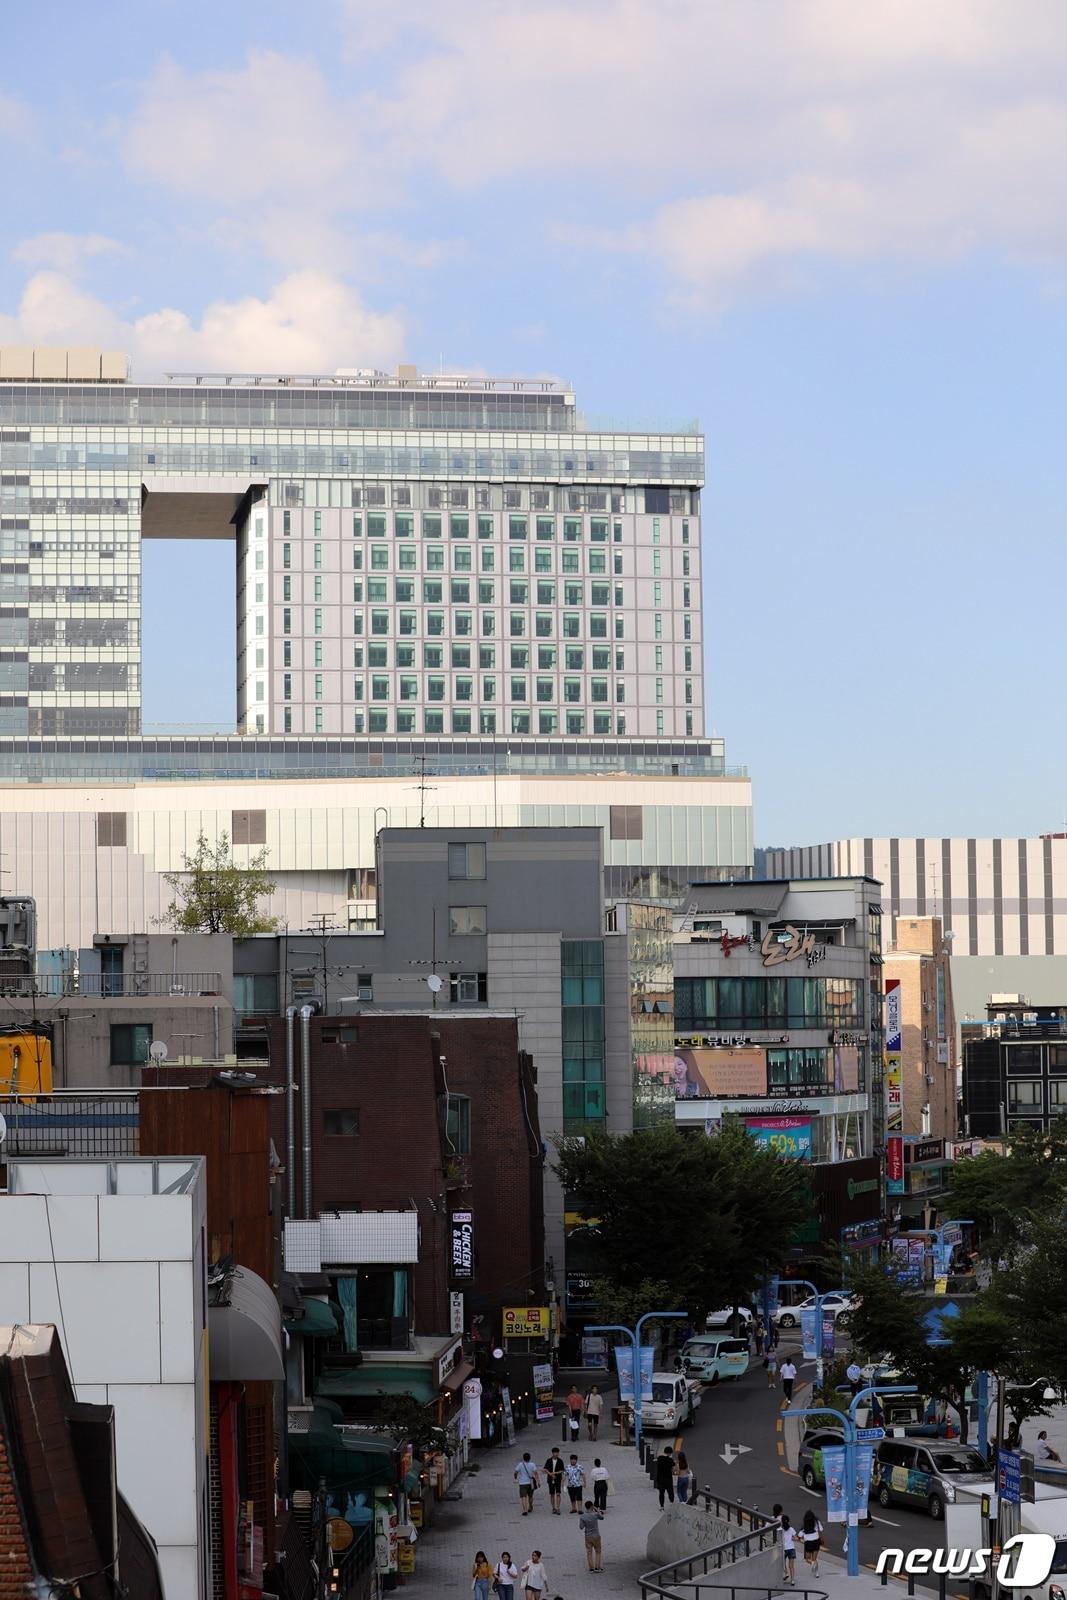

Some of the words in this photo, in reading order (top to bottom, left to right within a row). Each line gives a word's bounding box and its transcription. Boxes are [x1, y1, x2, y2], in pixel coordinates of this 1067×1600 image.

[677, 1035, 704, 1046] 노래
[888, 1079, 901, 1103] 노래
[769, 1134, 797, 1153] 50%
[453, 1229, 462, 1238] &
[452, 1238, 462, 1265] BEER
[461, 1223, 472, 1268] CHICKEN
[506, 1323, 541, 1334] 코인노래
